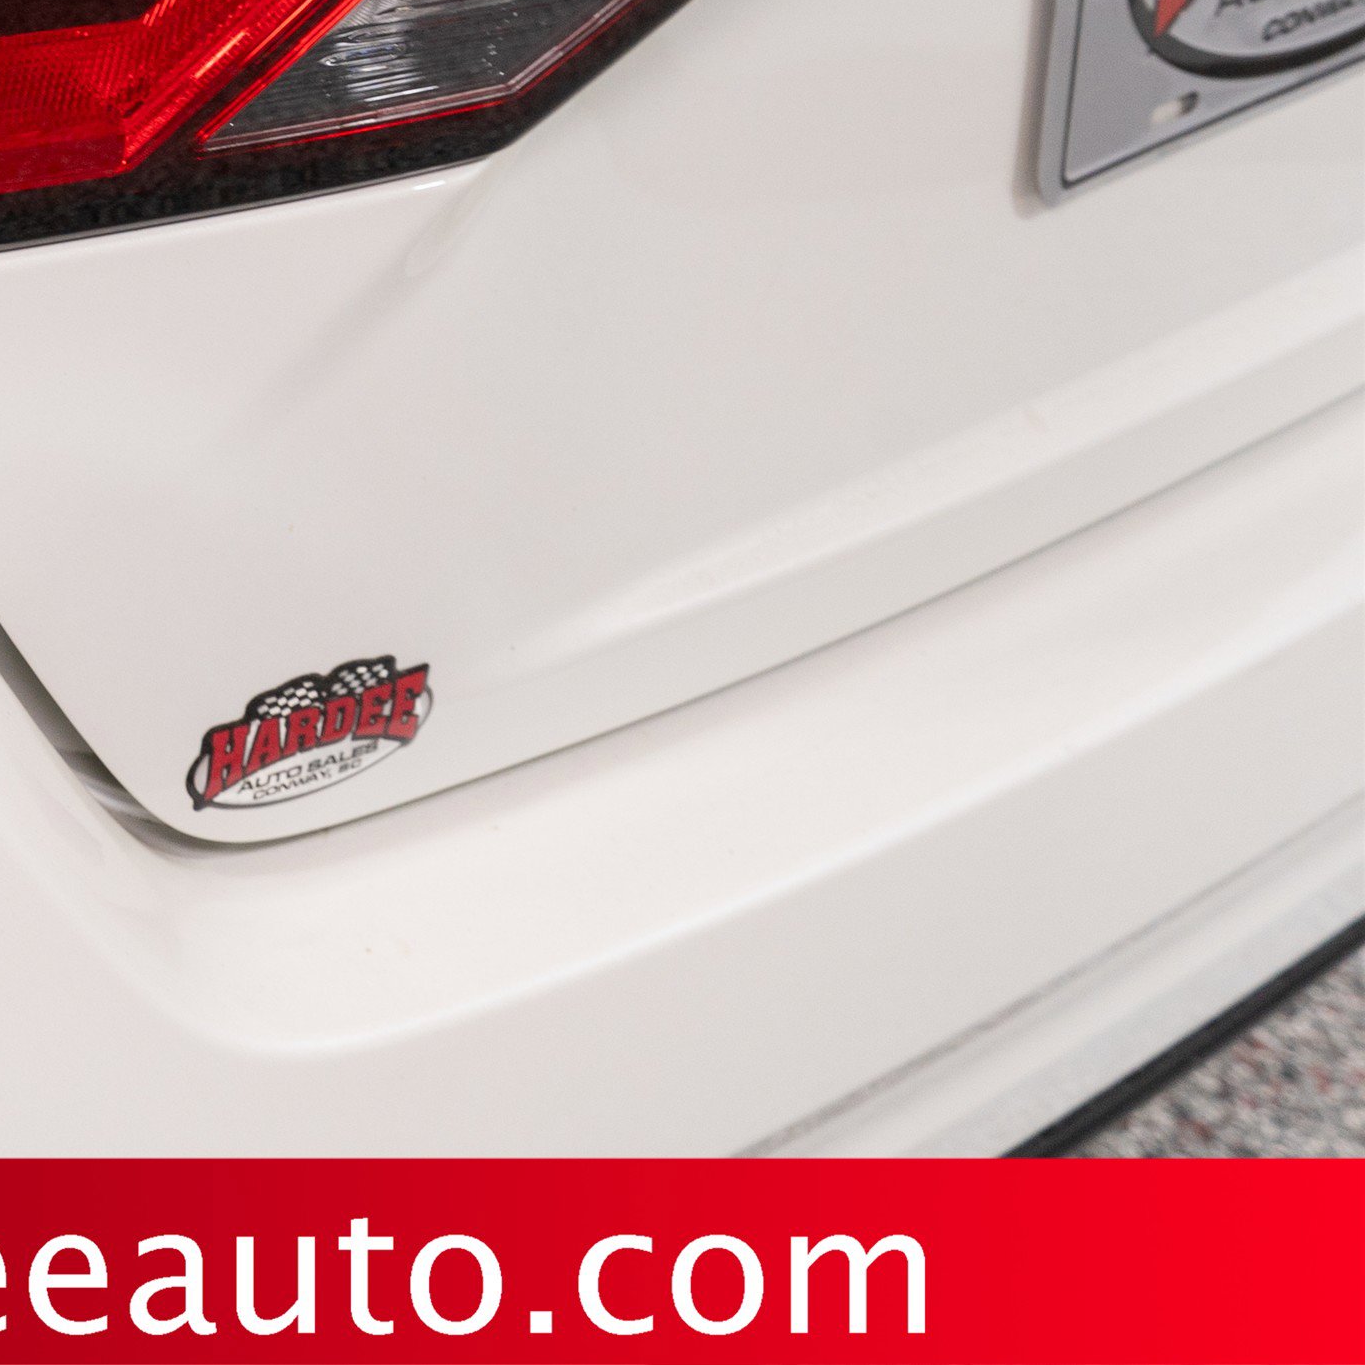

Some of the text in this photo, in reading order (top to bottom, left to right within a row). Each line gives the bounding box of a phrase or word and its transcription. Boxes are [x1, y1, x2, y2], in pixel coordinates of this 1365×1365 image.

[201, 667, 429, 803] HARDEE
[237, 739, 379, 794] AUTO SALES
